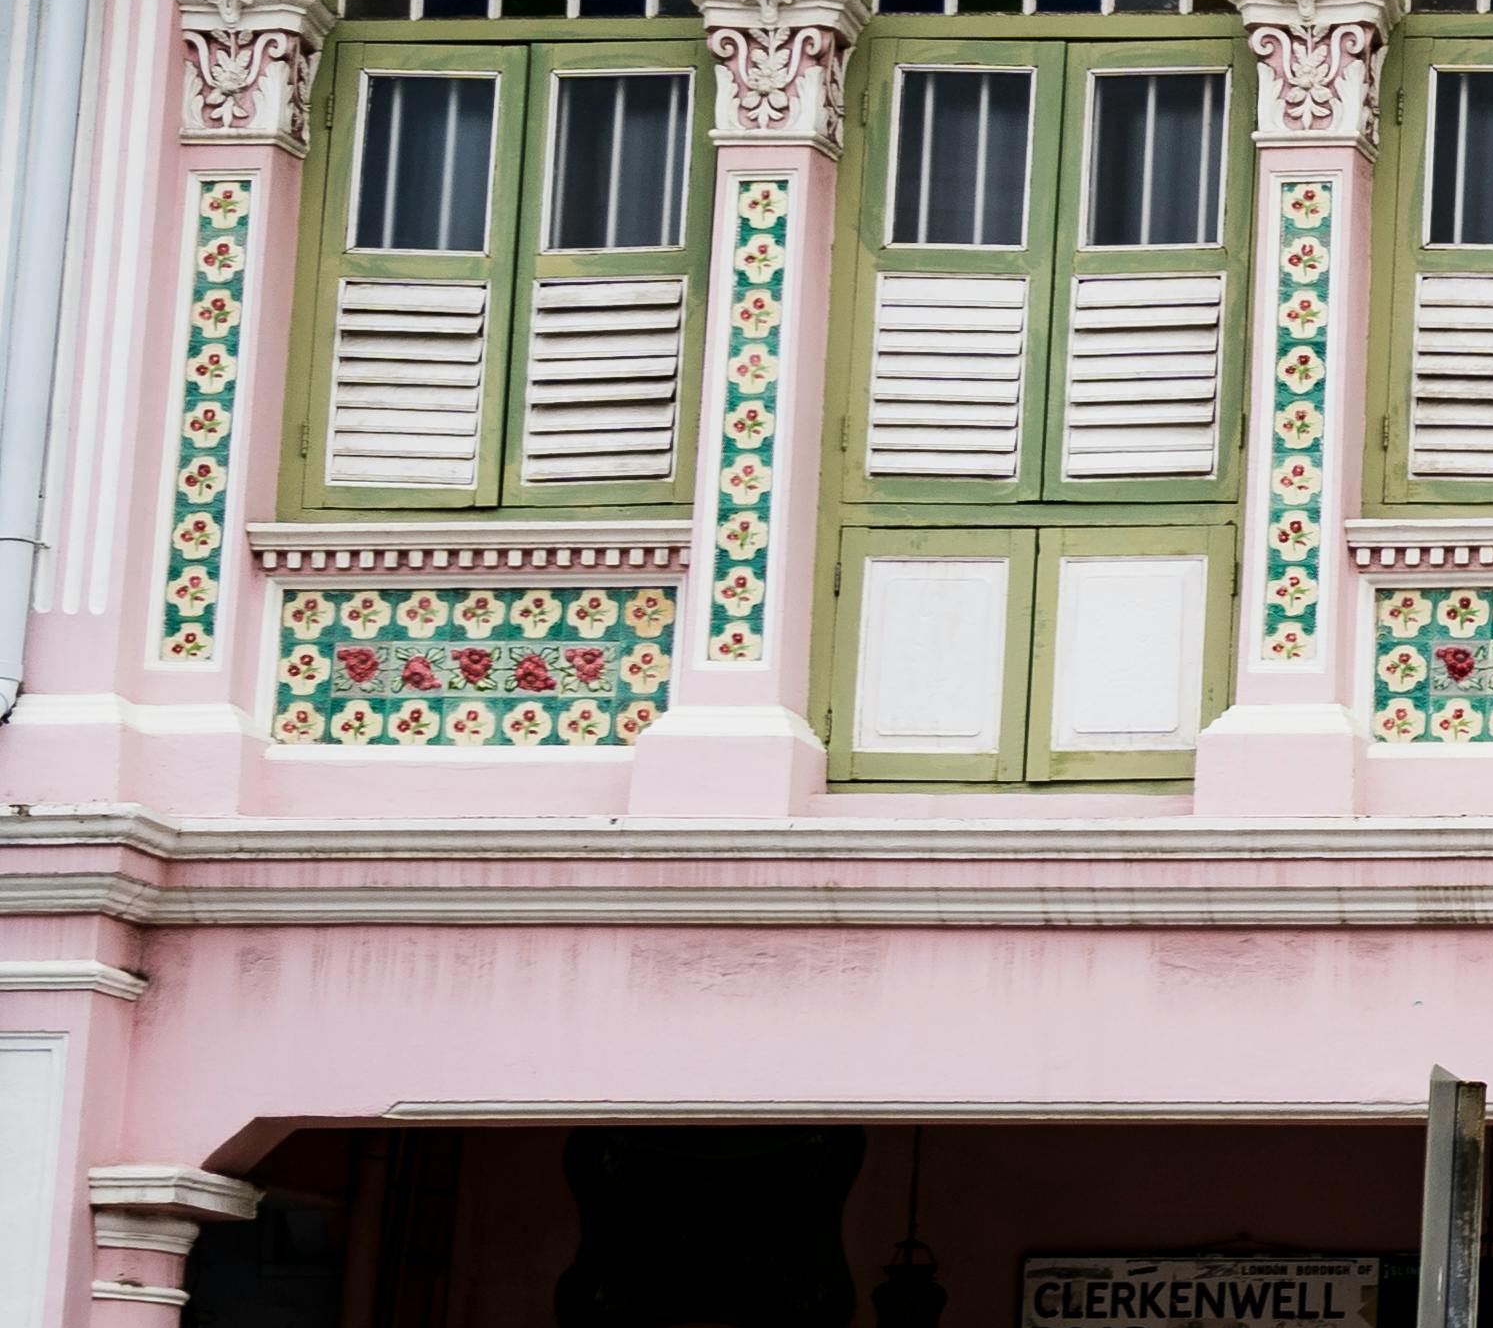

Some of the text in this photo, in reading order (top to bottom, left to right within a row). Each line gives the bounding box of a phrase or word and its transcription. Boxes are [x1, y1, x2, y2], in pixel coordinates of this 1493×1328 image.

[1242, 1265, 1288, 1276] LONDON
[1296, 1265, 1351, 1275] BOROUGH
[1357, 1265, 1373, 1275] OF
[1034, 1281, 1346, 1320] CLERKENWELL
